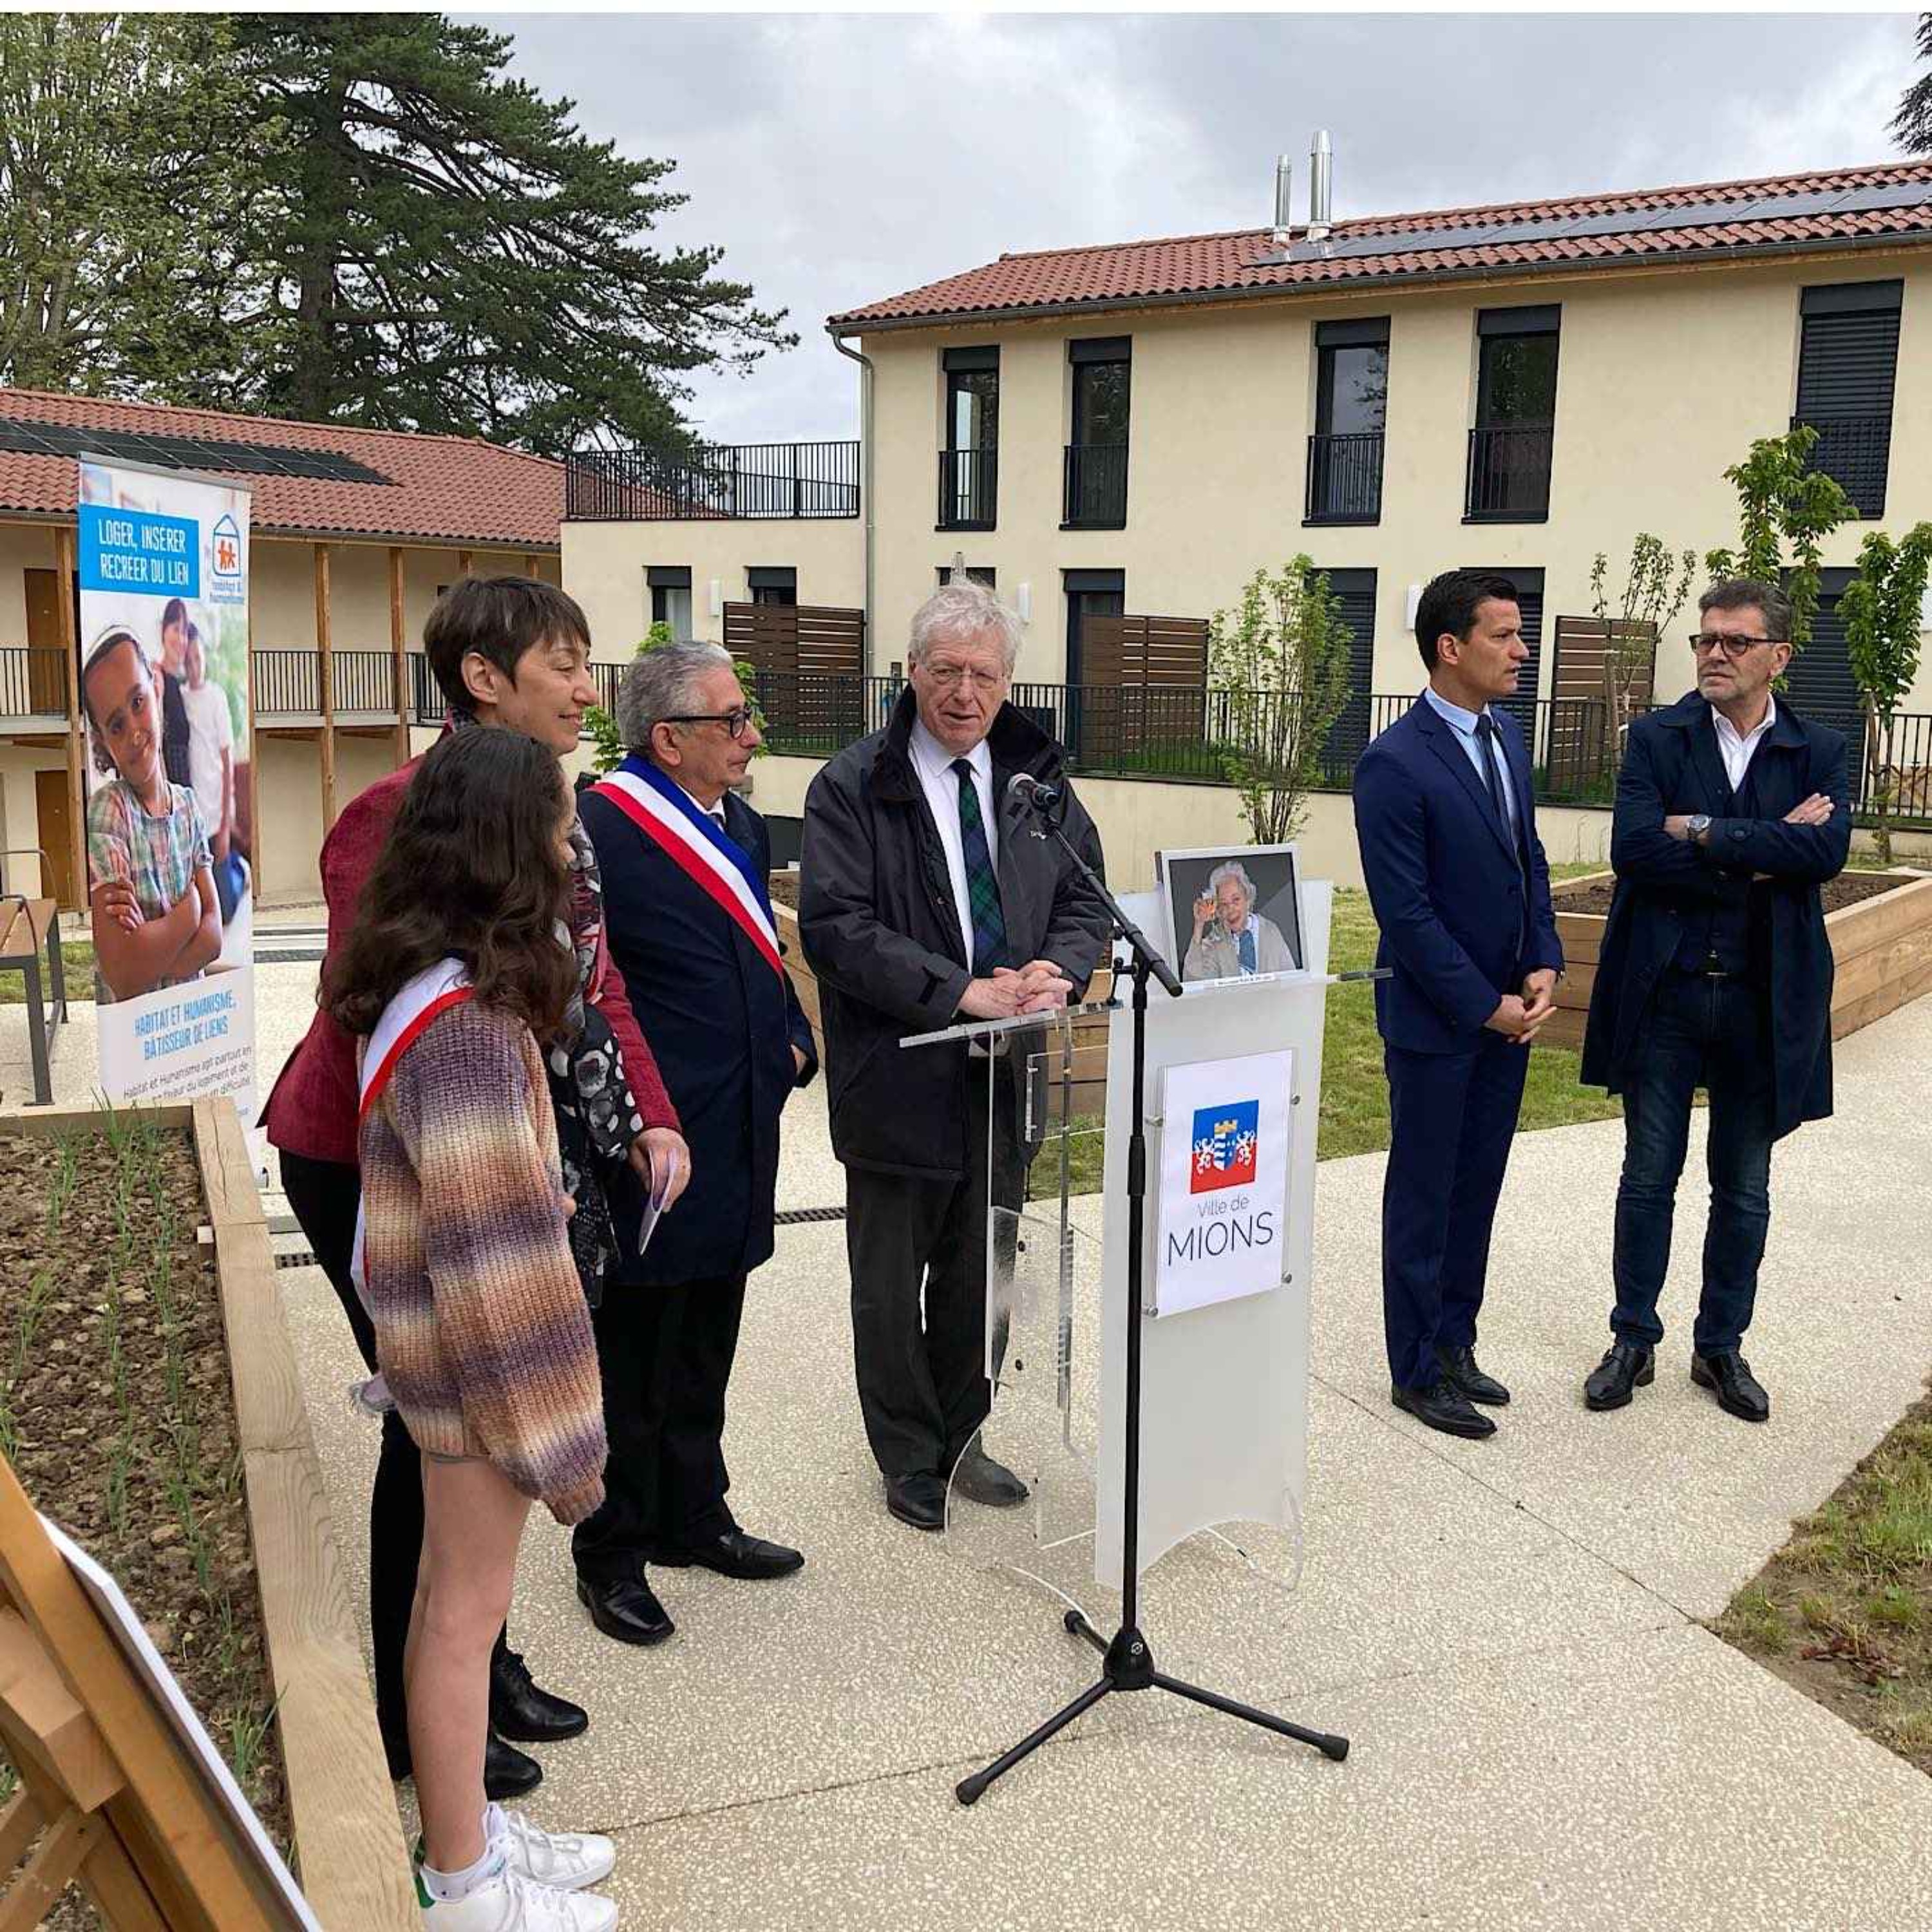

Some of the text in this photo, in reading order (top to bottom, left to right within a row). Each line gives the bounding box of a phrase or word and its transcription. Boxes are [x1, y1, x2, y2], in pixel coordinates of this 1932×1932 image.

[99, 518, 137, 552] LOGER,
[150, 558, 165, 583] DU
[168, 561, 189, 586] LIEN
[135, 1007, 169, 1038] HABITAT
[171, 1005, 180, 1026] ET
[194, 1023, 204, 1044] DE
[205, 1015, 229, 1039] LIENS
[1197, 1193, 1250, 1218] Ville de
[1168, 1211, 1274, 1267] MIONS
